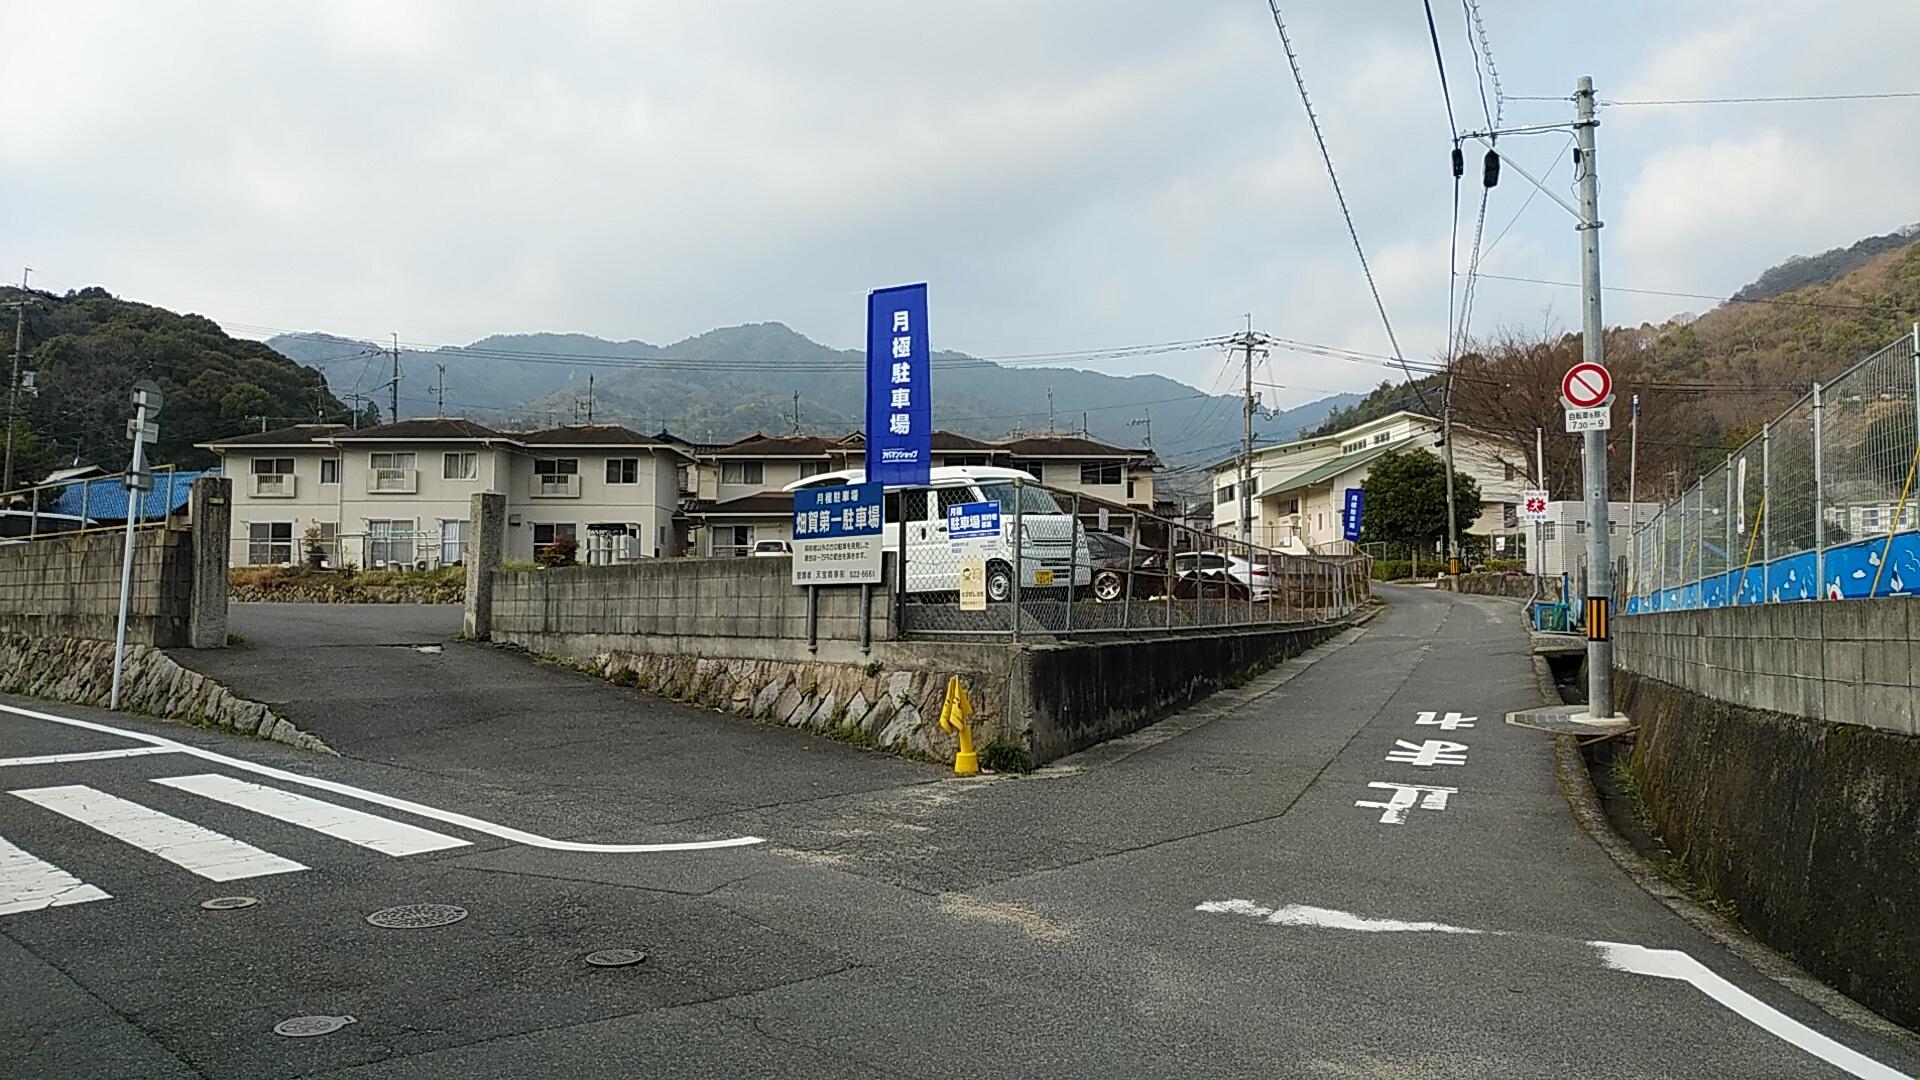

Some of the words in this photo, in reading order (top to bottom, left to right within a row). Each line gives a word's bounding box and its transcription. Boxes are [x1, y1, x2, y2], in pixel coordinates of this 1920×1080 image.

[890, 310, 911, 435] 月極駐車場
[1569, 411, 1607, 421] 自転車を除く
[816, 489, 858, 505] 月極駐車場
[950, 506, 963, 516] 月極
[796, 505, 880, 534] 畑賀第一駐車場
[950, 515, 980, 531] 駐車場
